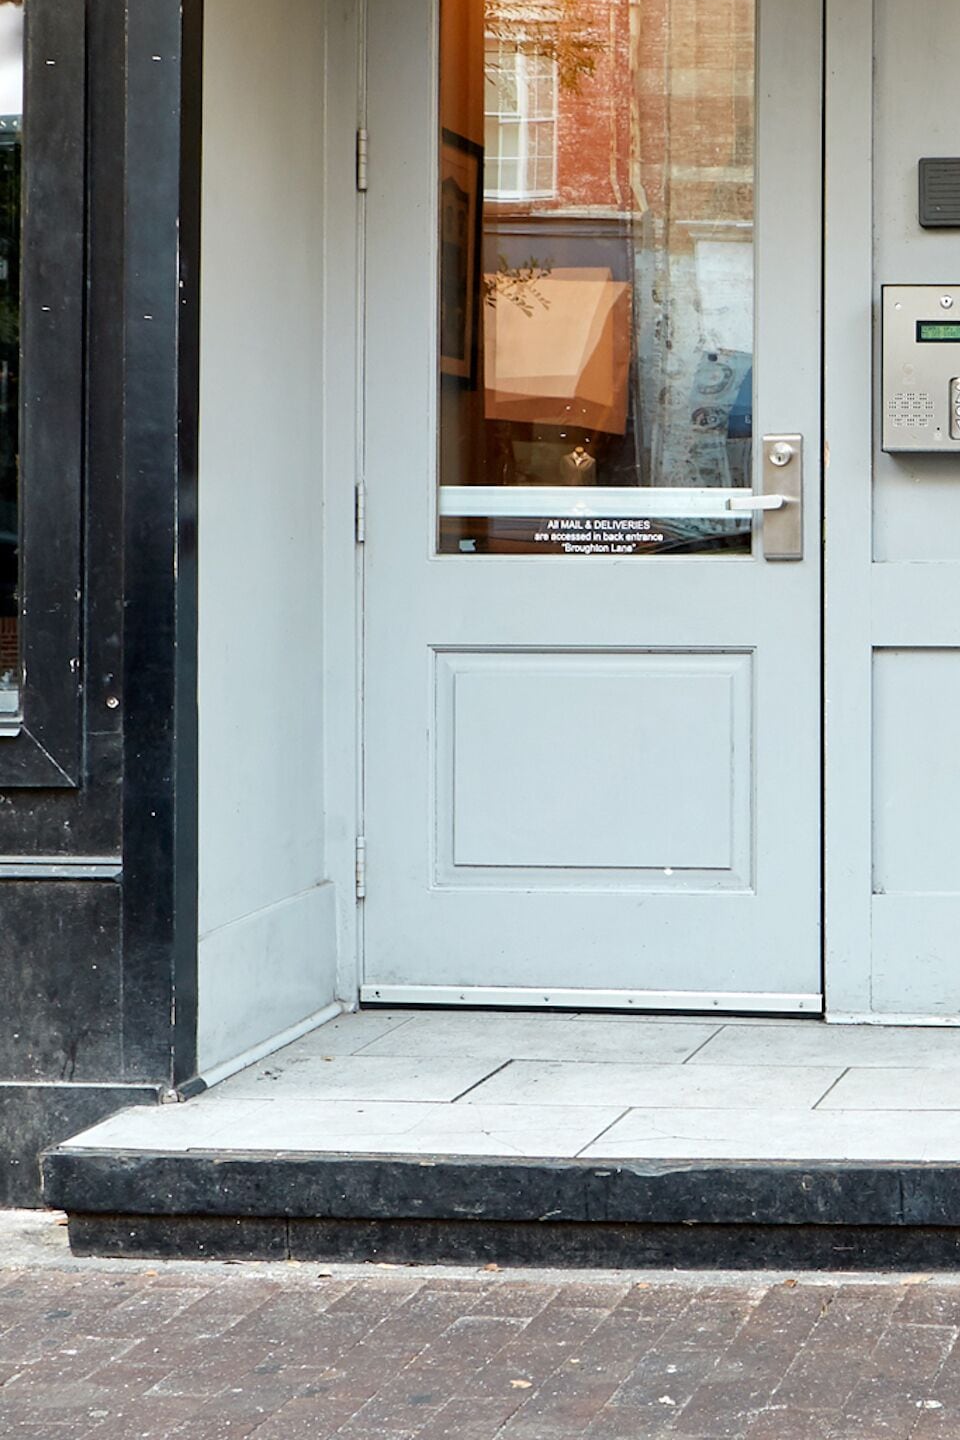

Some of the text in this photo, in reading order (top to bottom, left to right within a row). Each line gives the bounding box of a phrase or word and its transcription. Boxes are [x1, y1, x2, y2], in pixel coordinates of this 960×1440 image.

[547, 519, 651, 530] All MAIL & DELIVERIES
[534, 531, 664, 541] are accessed in back entrance
